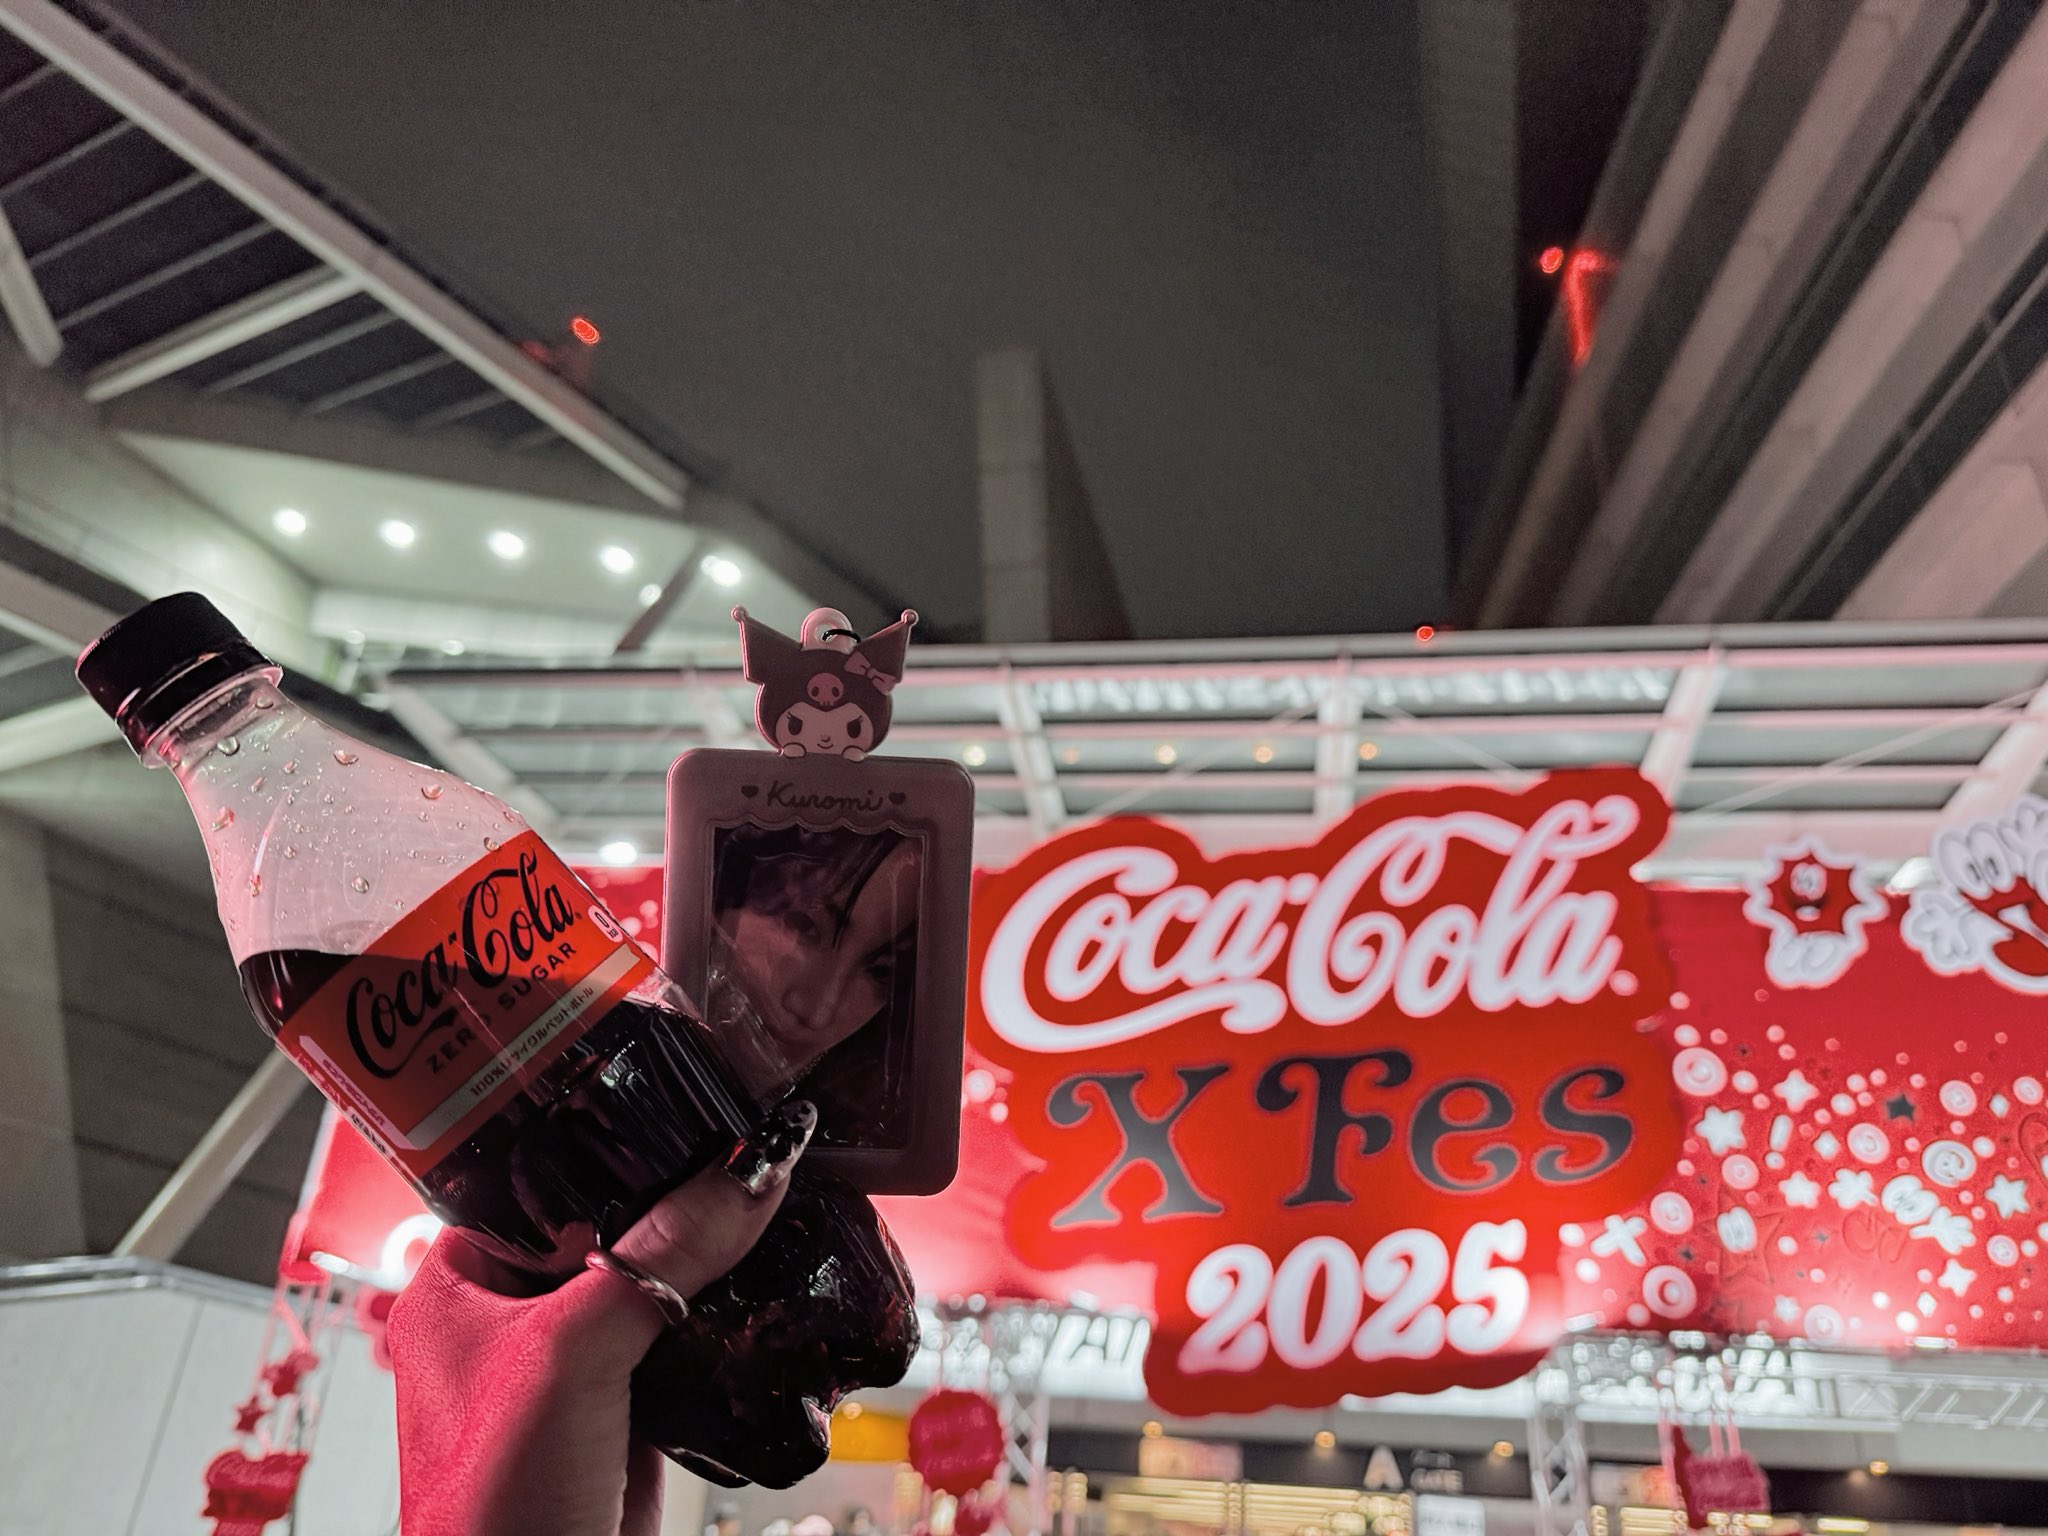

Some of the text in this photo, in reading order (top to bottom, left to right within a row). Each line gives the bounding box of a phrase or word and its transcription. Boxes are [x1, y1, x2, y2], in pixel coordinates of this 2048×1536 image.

[766, 780, 883, 811] Kuromi
[346, 849, 576, 1079] Coca-Cola
[497, 942, 577, 1009] SUGAR
[980, 795, 1640, 1053] Coca-Cola
[1046, 1048, 1635, 1230] X Fes
[1177, 1218, 1531, 1375] 2025
